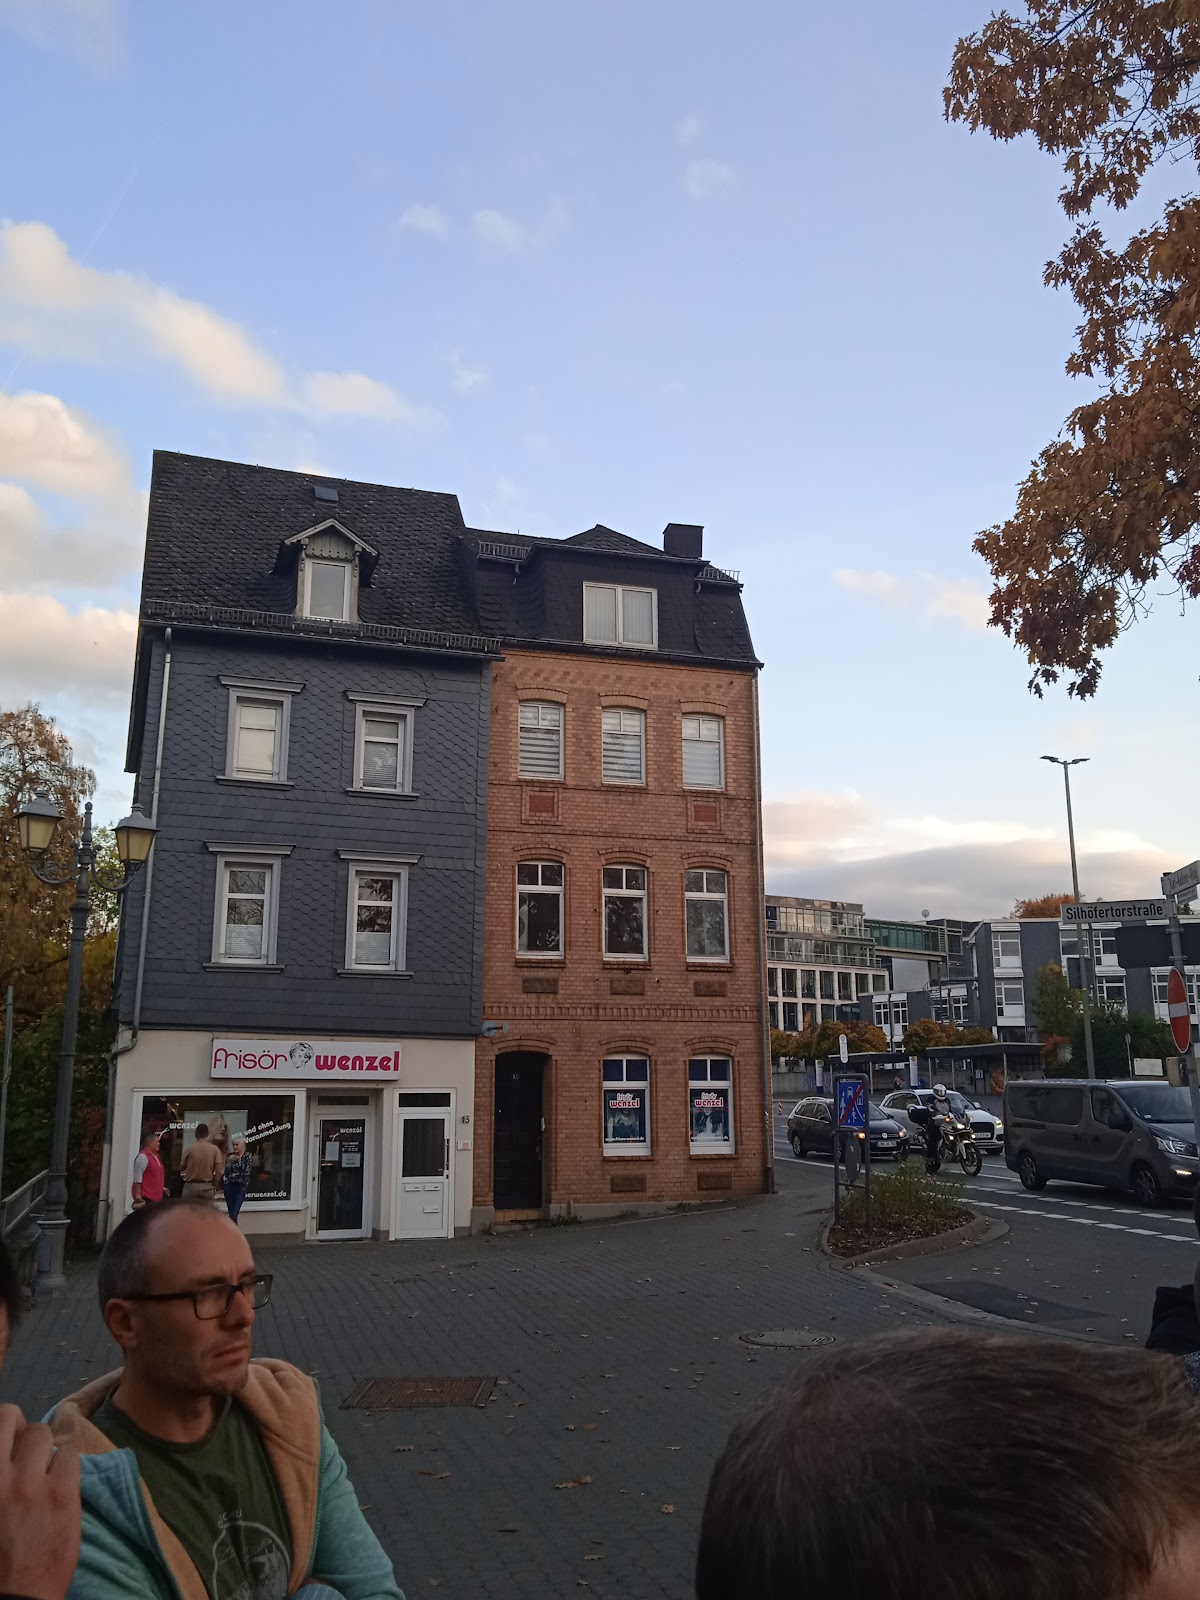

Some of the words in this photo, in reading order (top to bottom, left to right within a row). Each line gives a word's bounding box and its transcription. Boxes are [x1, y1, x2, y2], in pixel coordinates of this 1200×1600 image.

[1066, 903, 1163, 920] Silhöfertorstraße
[314, 1050, 400, 1072] wenzel
[610, 1098, 640, 1108] wenzel
[695, 1097, 724, 1107] wenzel
[244, 1126, 257, 1135] und
[258, 1120, 274, 1130] ohne
[244, 1122, 291, 1144] Voranmeldung
